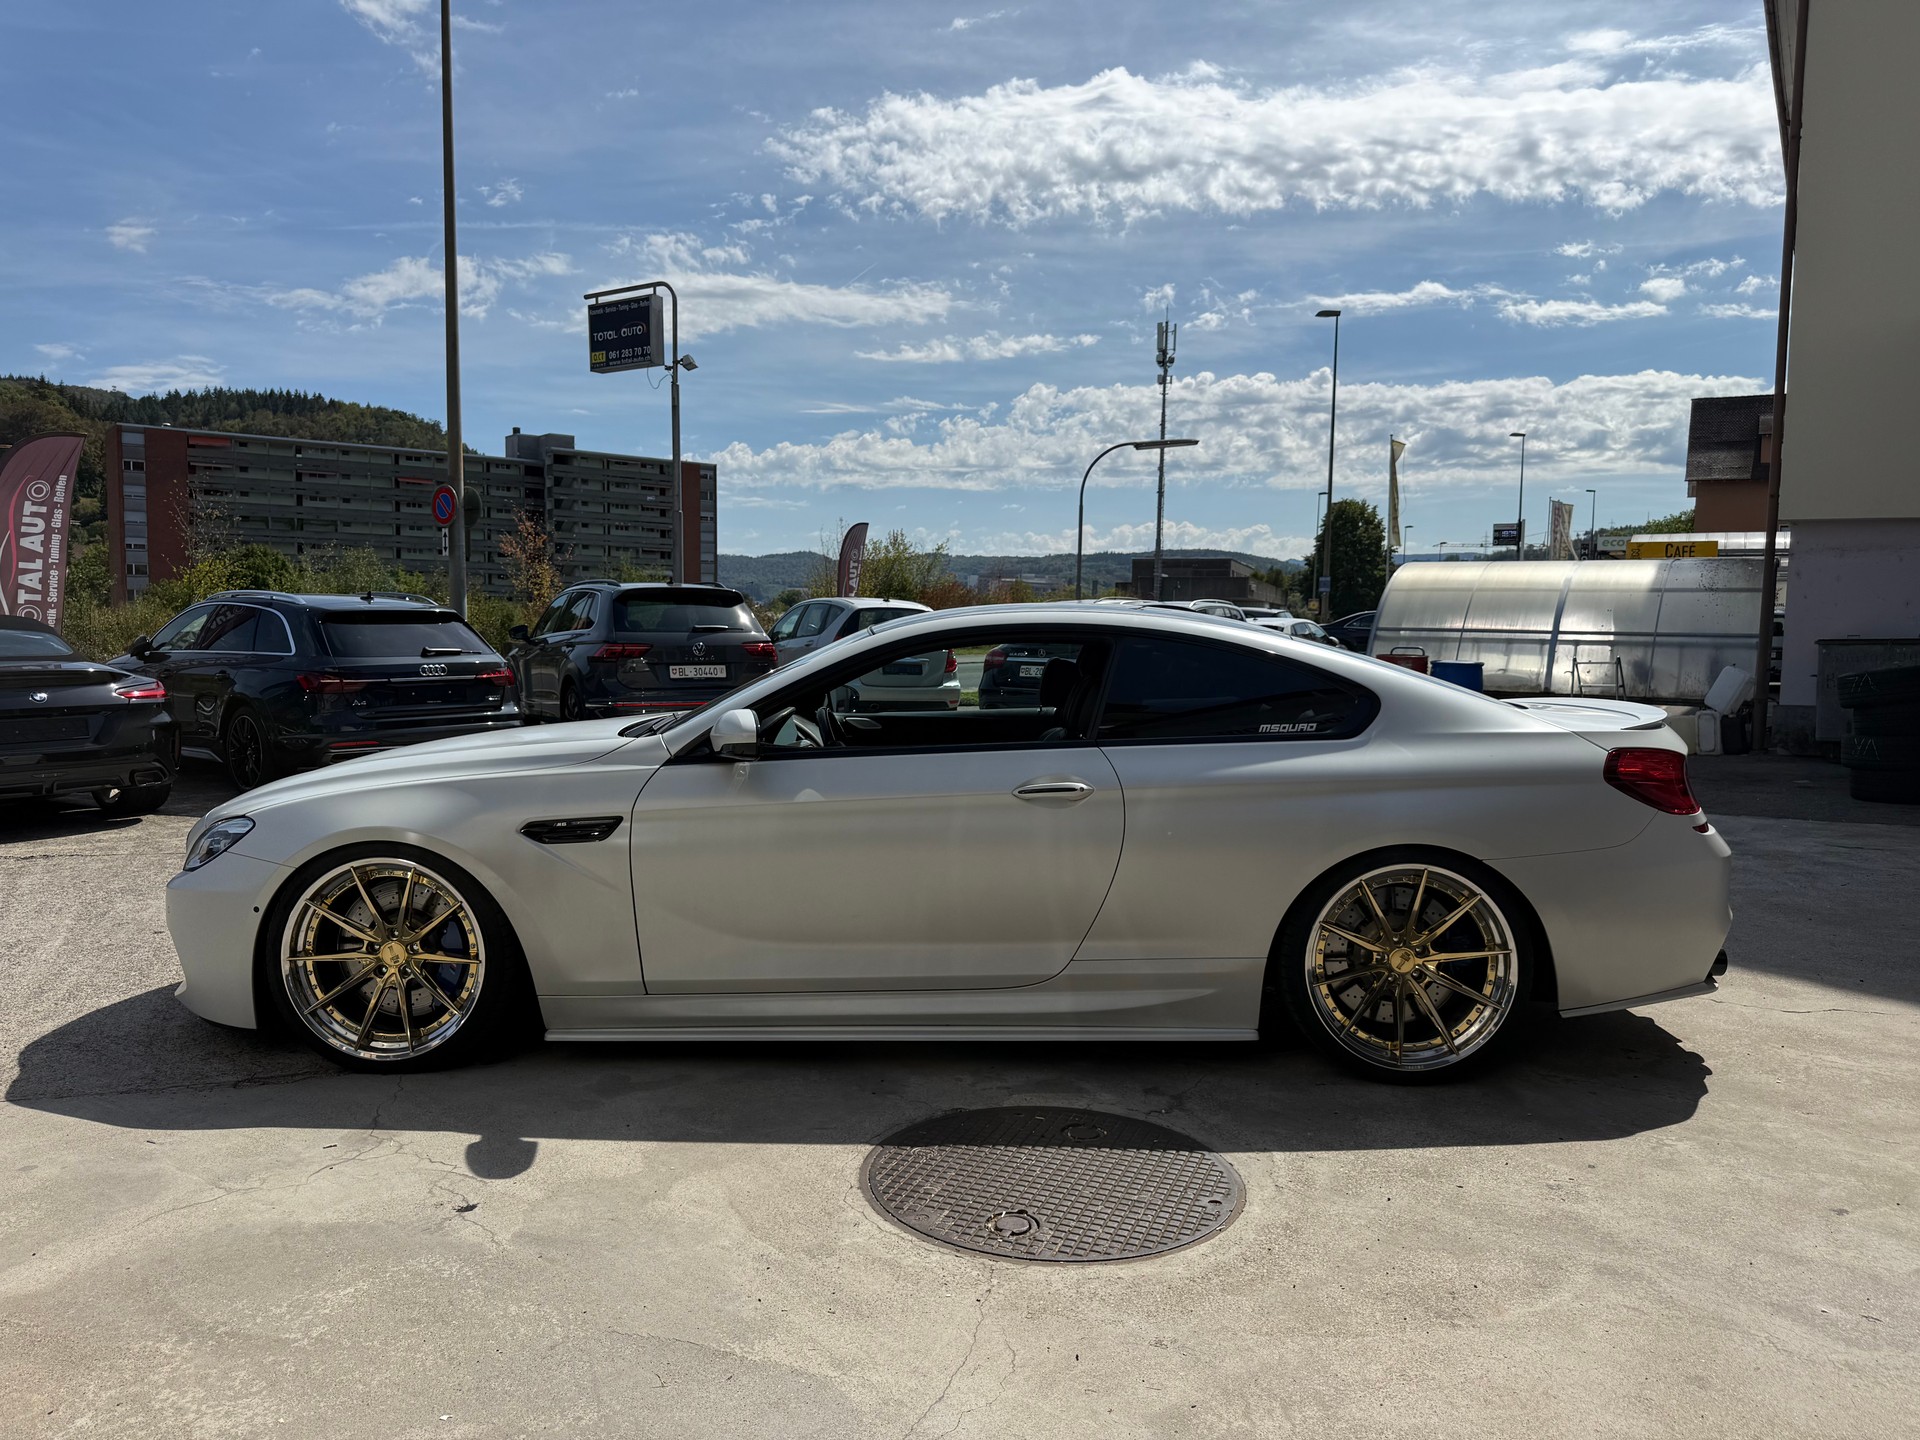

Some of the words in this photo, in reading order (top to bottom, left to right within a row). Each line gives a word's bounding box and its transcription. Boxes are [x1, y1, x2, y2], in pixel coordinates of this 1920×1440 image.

[608, 350, 620, 360] 061
[621, 348, 633, 358] 283
[634, 346, 642, 356] 70
[643, 345, 651, 354] 70
[54, 474, 68, 504] Reifen
[19, 480, 51, 553] AUTO
[51, 508, 63, 528] Glas
[49, 533, 62, 564] Tuning
[17, 558, 43, 622] OTAL
[47, 569, 59, 603] Service
[1258, 723, 1317, 733] MSQUAD
